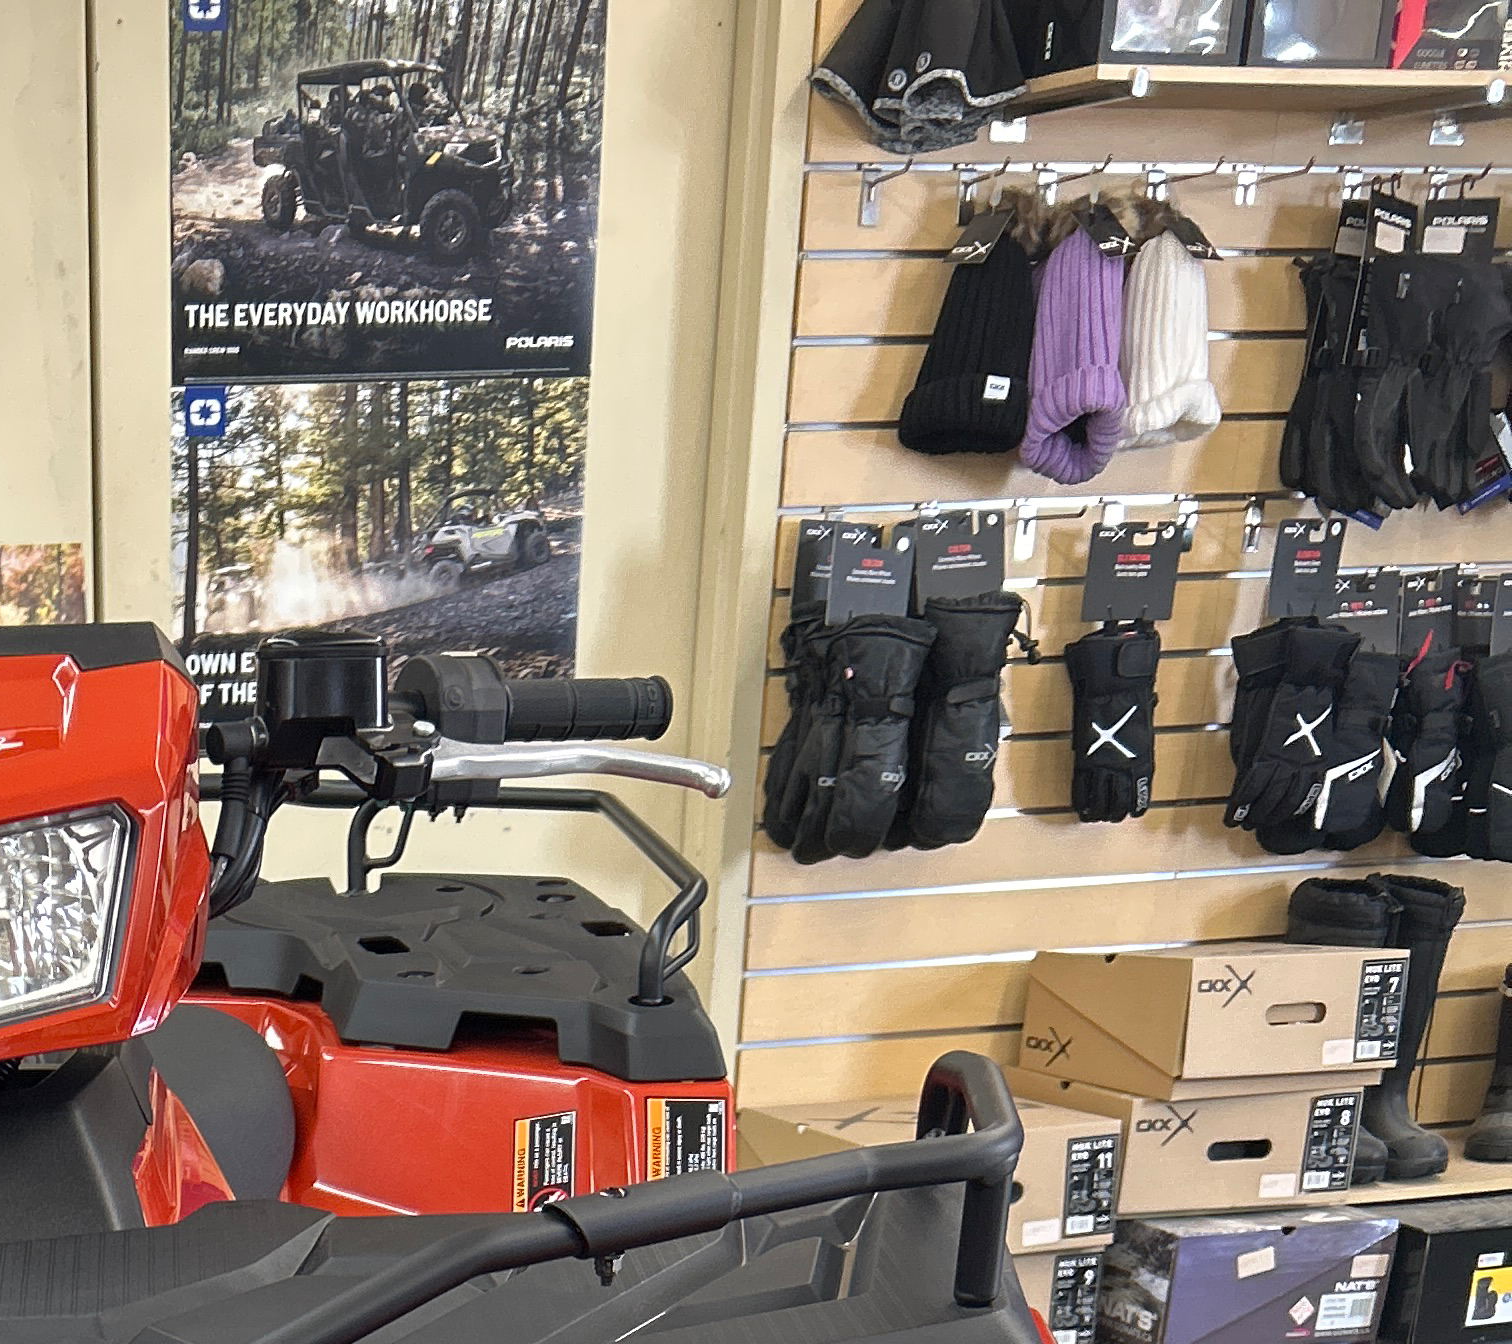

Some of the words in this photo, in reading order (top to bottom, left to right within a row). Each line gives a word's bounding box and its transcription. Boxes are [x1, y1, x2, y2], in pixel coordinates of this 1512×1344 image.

[1374, 207, 1412, 228] POLARIS
[1432, 215, 1489, 226] POLARIS
[184, 304, 230, 328] THE
[234, 301, 350, 327] EVERYDAY
[356, 298, 493, 324] WORKHORSE
[505, 335, 575, 349] POLARIS
[185, 652, 236, 676] OWN
[218, 681, 257, 705] THE
[1389, 976, 1400, 993] 7
[1340, 1109, 1351, 1126] 8
[652, 1126, 662, 1178] WARNING
[1097, 1151, 1113, 1169] 11
[517, 1147, 526, 1198] WARNING
[1084, 1269, 1095, 1286] 9
